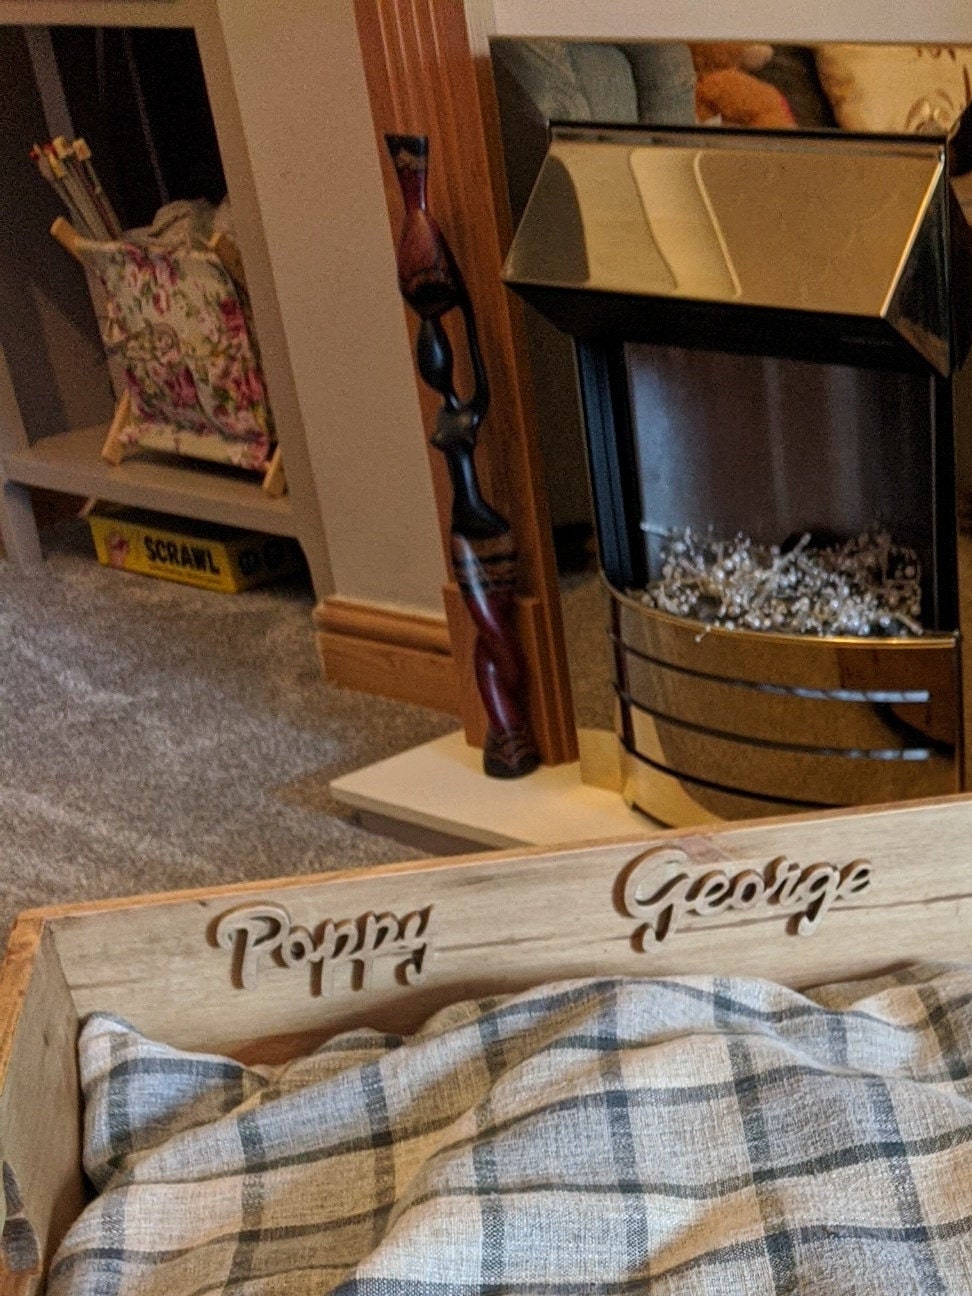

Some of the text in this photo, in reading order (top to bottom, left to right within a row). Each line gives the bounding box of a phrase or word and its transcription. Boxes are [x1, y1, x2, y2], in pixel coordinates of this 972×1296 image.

[144, 535, 221, 575] SCRAWL
[206, 901, 435, 997] Poppy
[612, 844, 873, 953] George
